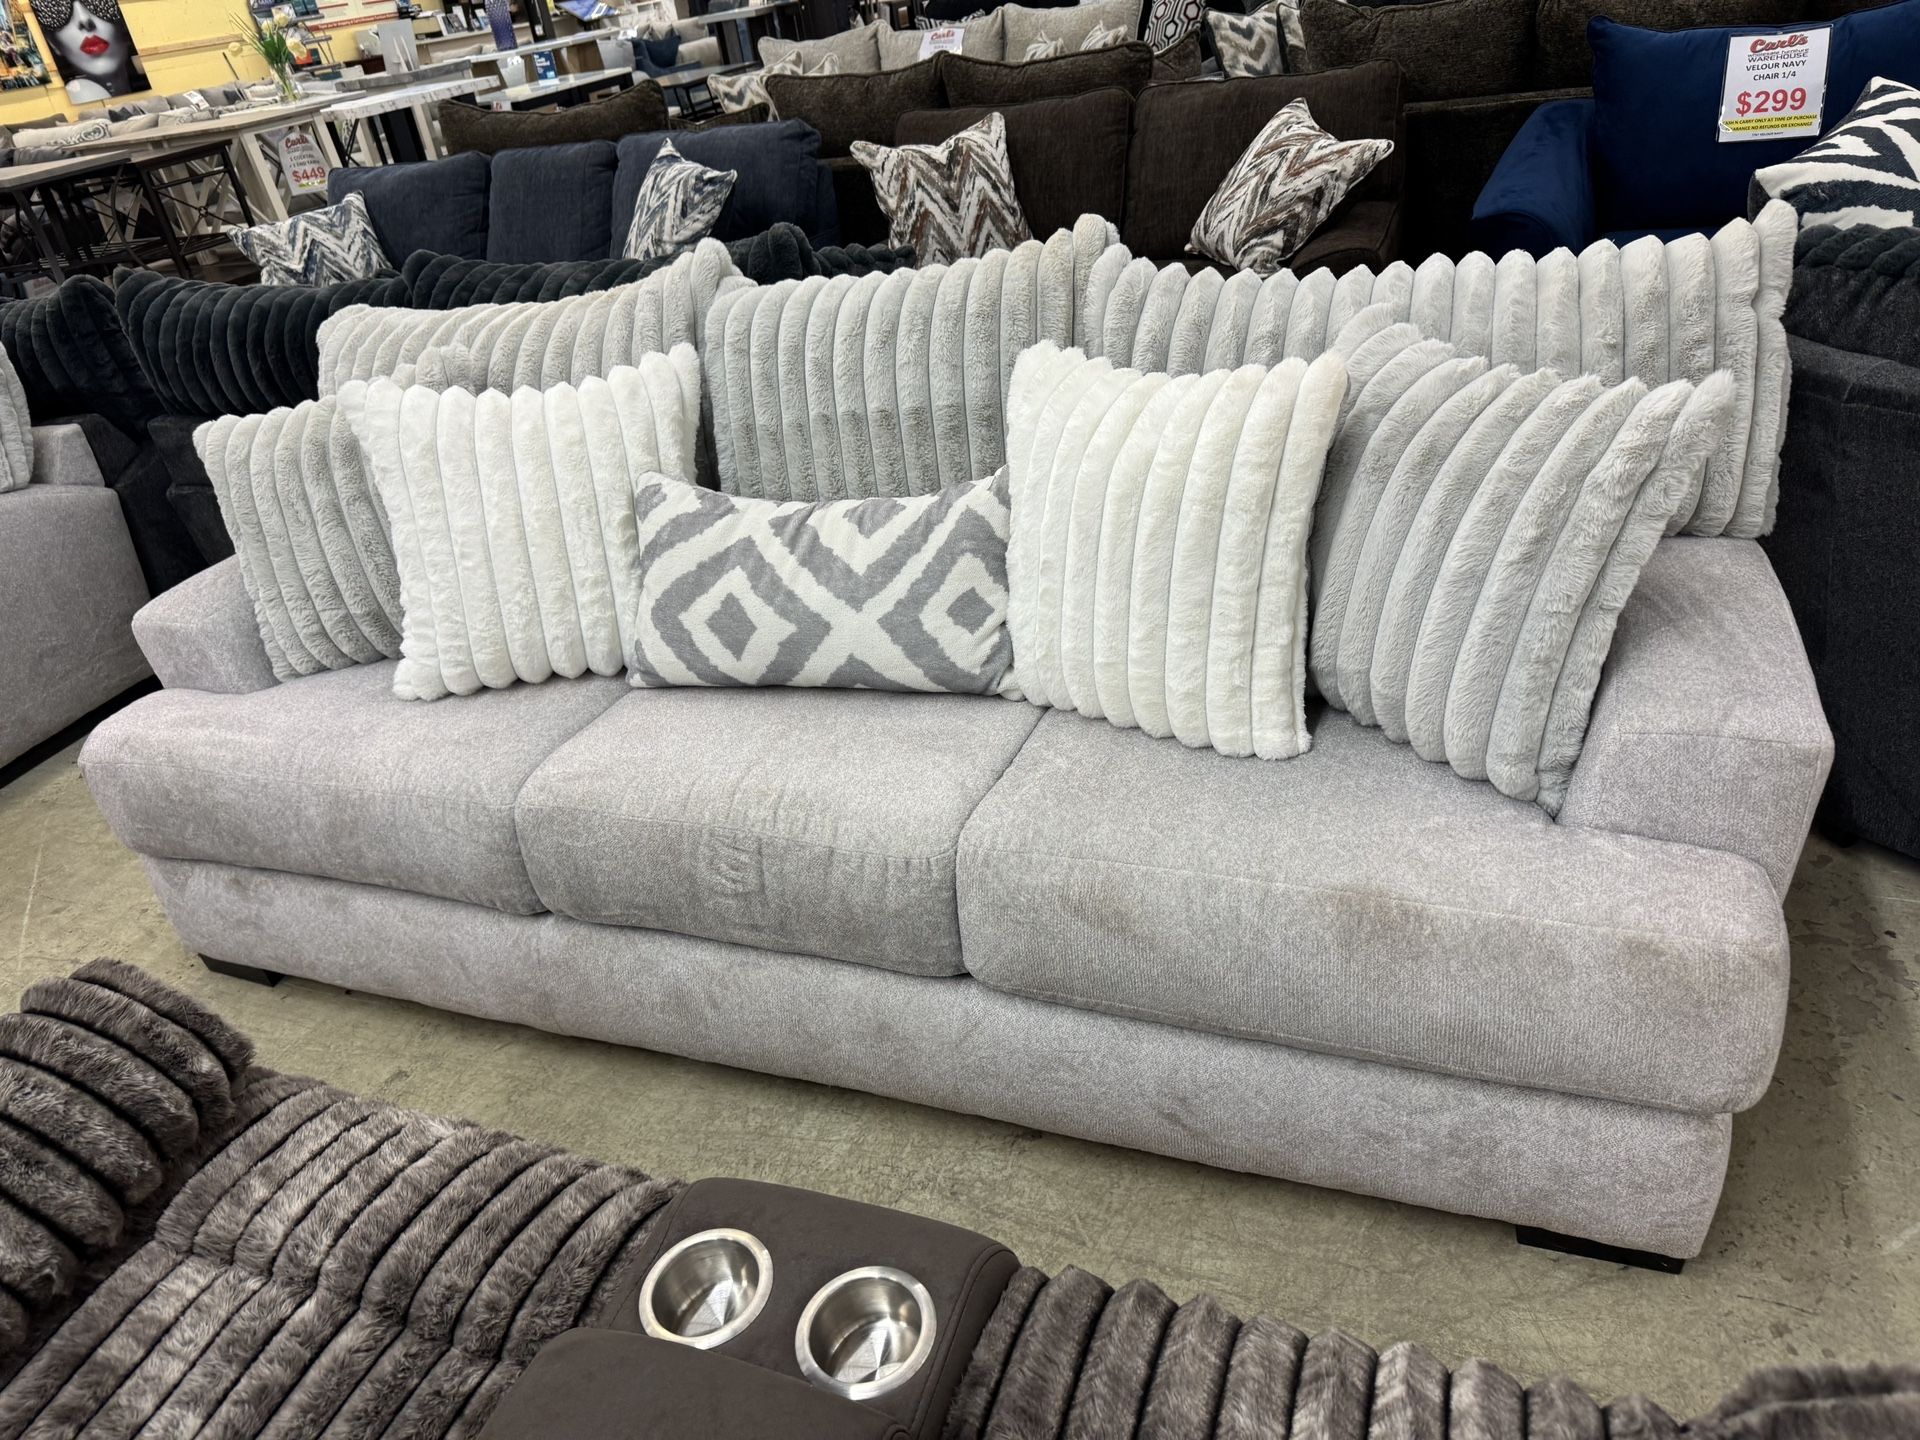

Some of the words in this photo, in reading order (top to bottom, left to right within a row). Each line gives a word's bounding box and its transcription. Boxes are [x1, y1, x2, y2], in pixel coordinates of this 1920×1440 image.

[1750, 34, 1808, 53] Carl's
[1748, 52, 1808, 62] WAREHOUSE
[1746, 62, 1780, 72] VELOUR
[1782, 60, 1806, 68] NAVY
[1753, 73, 1780, 81] CHAIR
[1782, 70, 1796, 79] 1/4
[1736, 87, 1807, 117] $299
[292, 166, 326, 182] $449
